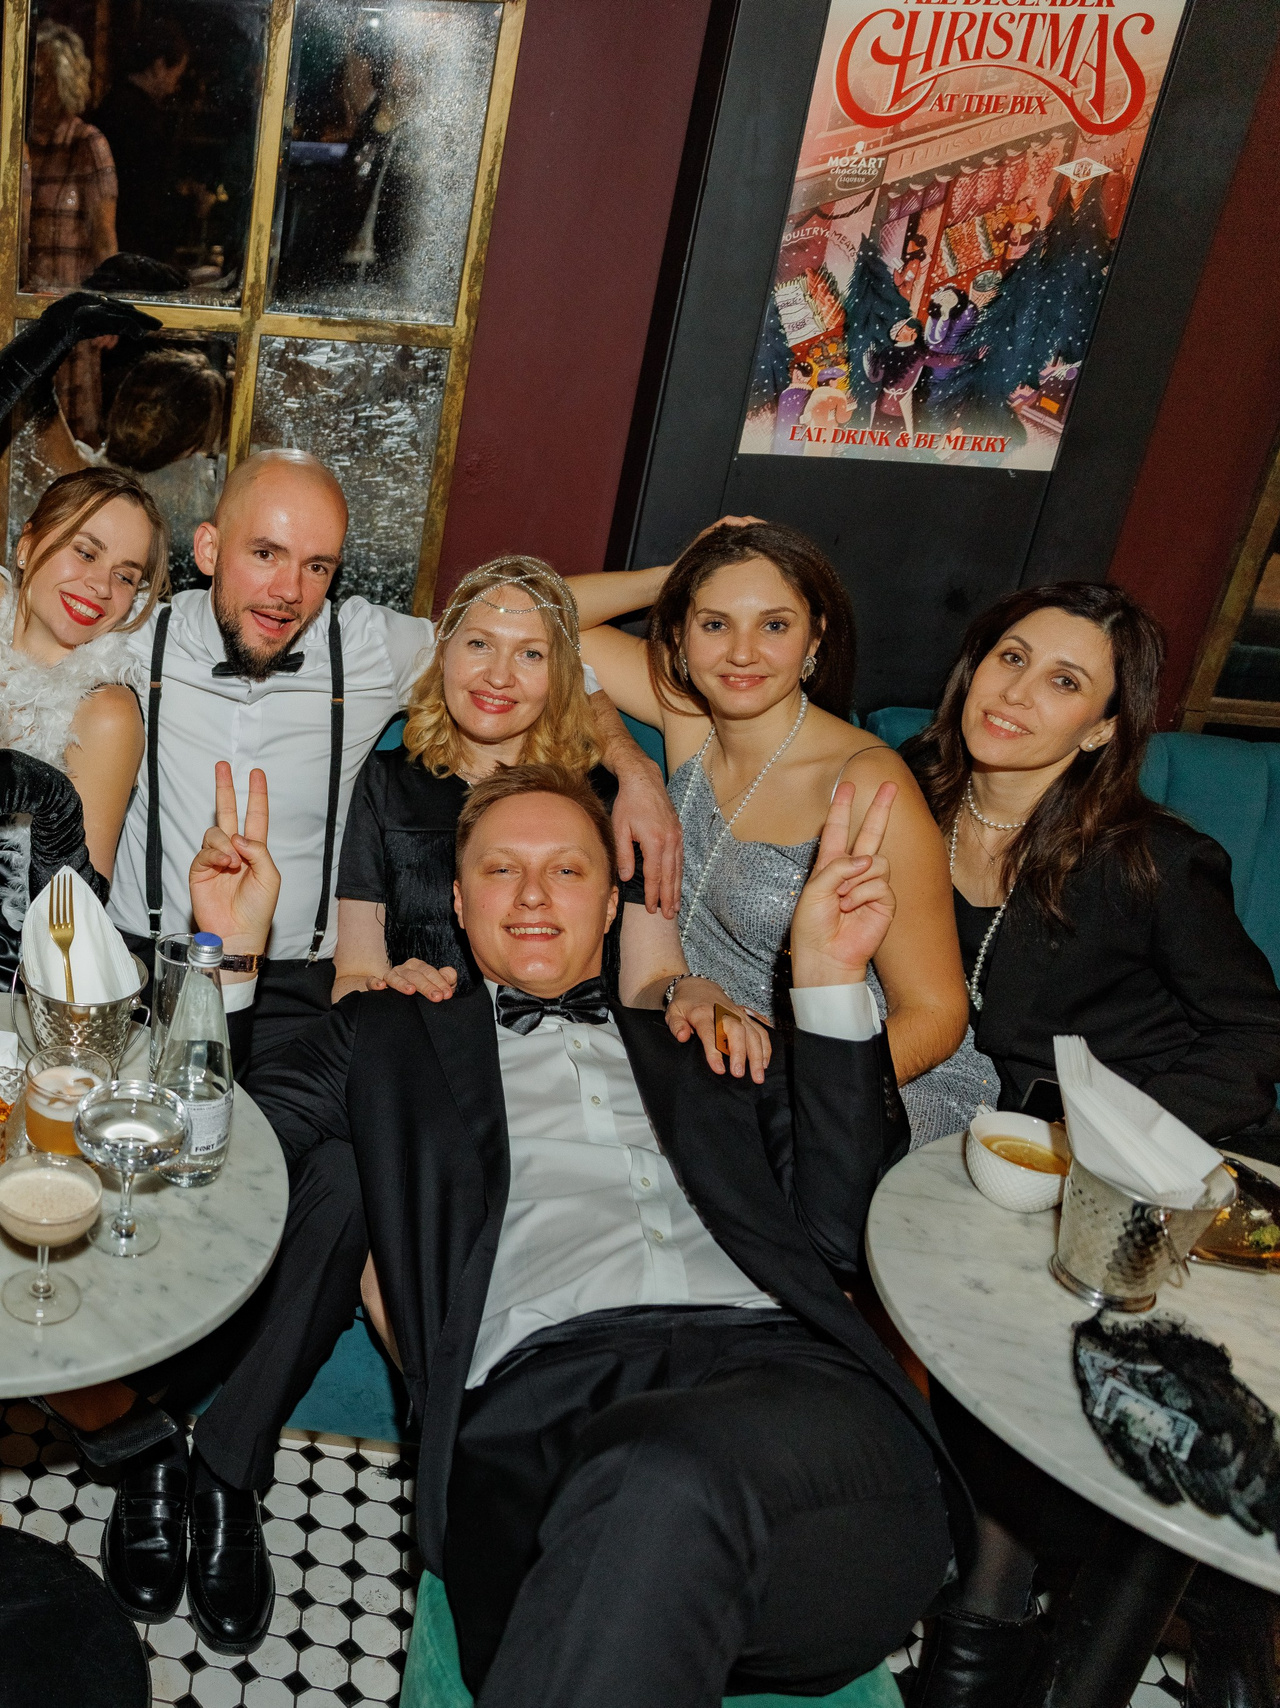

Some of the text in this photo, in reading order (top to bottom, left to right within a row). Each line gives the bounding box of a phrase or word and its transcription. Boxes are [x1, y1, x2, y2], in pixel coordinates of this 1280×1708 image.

[834, 8, 1155, 135] CHRISTMAS
[928, 94, 1049, 115] AT THE BIX
[827, 155, 885, 169] MOZART
[830, 166, 879, 176] chocolate
[789, 425, 1011, 453] EAT, DRINK & BE MERRY
